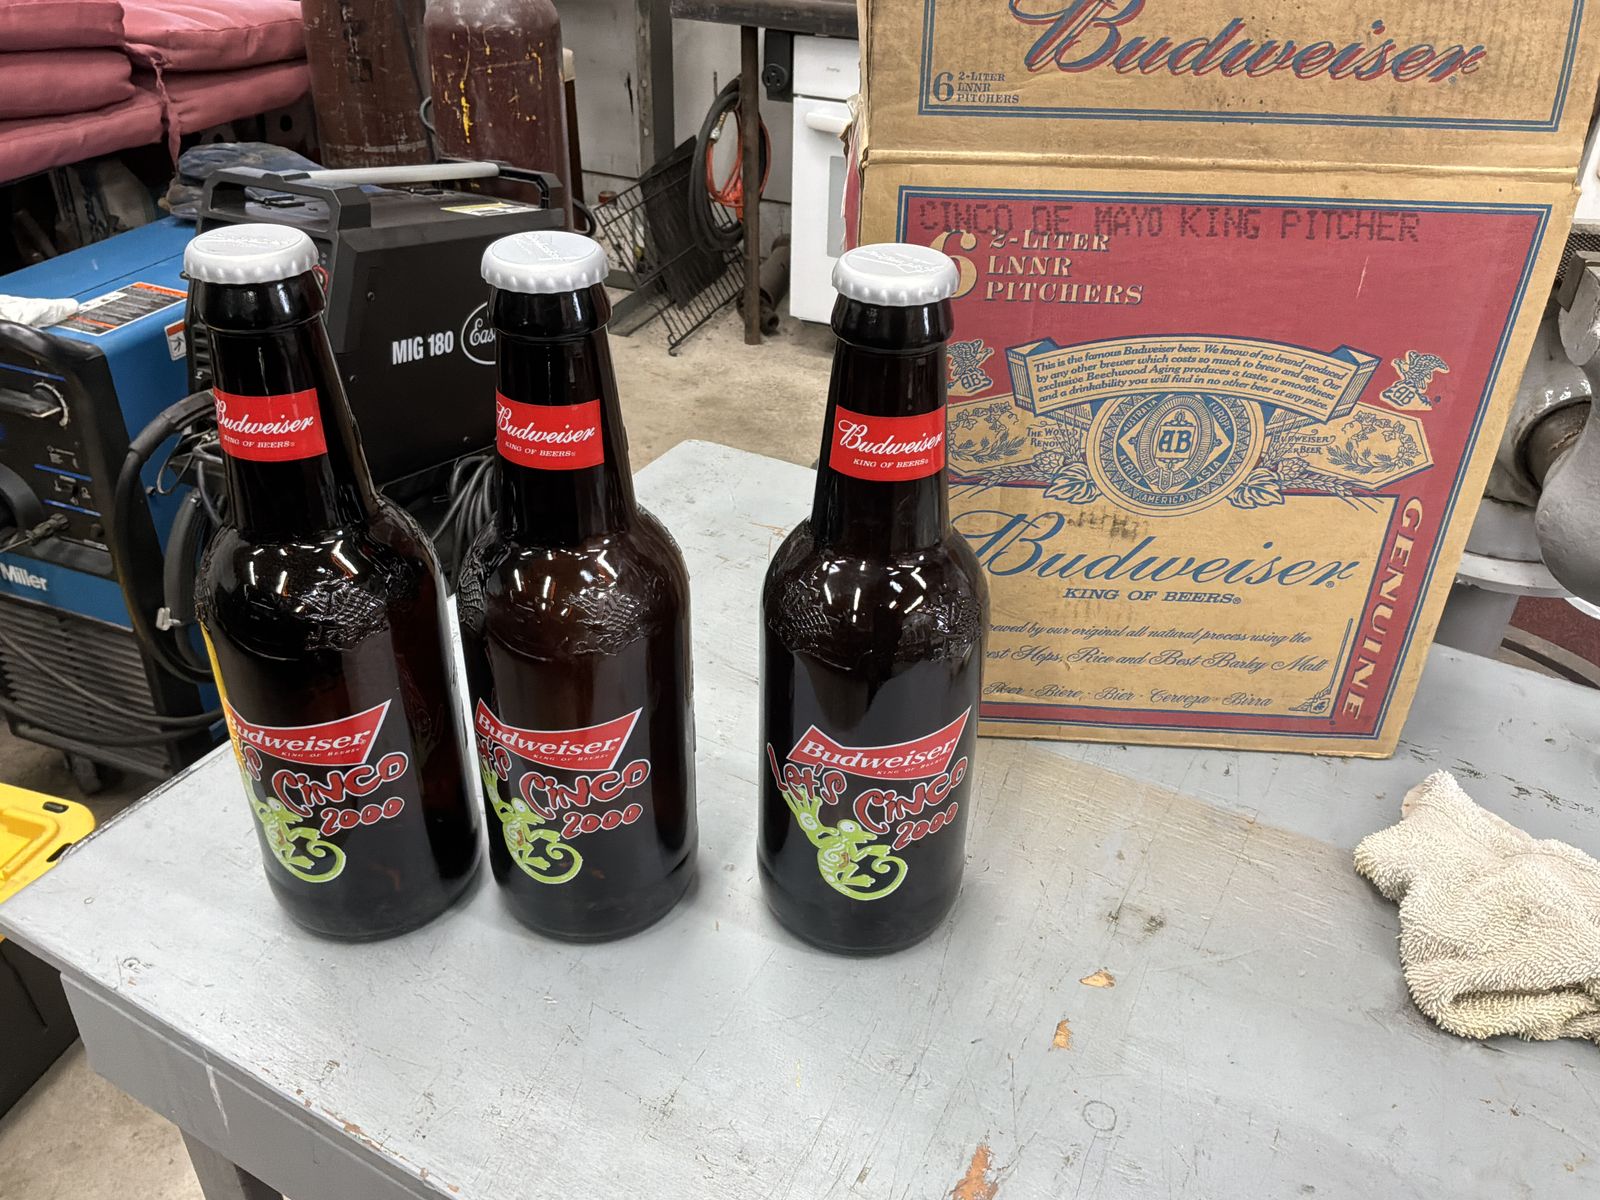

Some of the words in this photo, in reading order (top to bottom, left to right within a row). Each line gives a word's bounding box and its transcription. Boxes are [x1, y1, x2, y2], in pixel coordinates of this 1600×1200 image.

[1010, 0, 1487, 83] Budweiser
[933, 72, 954, 101] 6
[957, 82, 991, 92] LNNR
[958, 71, 1005, 82] 2-LITER
[957, 93, 1020, 104] PITCHERS
[920, 201, 1013, 235] CINCO
[1032, 205, 1073, 236] DE
[1094, 206, 1163, 237] MAYO
[1180, 207, 1262, 240] KING
[1280, 209, 1421, 243] PITCHER
[989, 228, 1110, 252] 2-LITER
[986, 255, 1073, 278] LNNR
[984, 280, 1143, 306] PITCHERS
[392, 336, 424, 365] MIG
[427, 330, 454, 357] 180
[470, 318, 497, 347] Eas
[1034, 361, 1056, 373] This
[1057, 358, 1066, 368] is
[1067, 355, 1083, 367] the
[1085, 350, 1122, 363] famous
[1123, 344, 1177, 356] Budweiser
[1203, 344, 1219, 354] We
[1220, 345, 1249, 357] know
[1250, 349, 1262, 359] of
[1262, 352, 1275, 361] no
[1275, 353, 1305, 367] brand
[1302, 362, 1349, 380] produced
[1036, 373, 1048, 383] by
[1050, 370, 1069, 380] any
[1071, 364, 1098, 375] other
[1100, 358, 1136, 369] brewer
[1137, 353, 1169, 365] which
[1171, 355, 1196, 364] costs
[1198, 356, 1210, 364] so
[1212, 355, 1241, 367] much
[1243, 359, 1254, 369] to
[1255, 360, 1281, 373] brew
[1281, 366, 1304, 379] and
[1322, 378, 1342, 391] Our
[1038, 377, 1084, 393] exclusive
[1086, 365, 1148, 382] Beechwood
[1148, 365, 1182, 375] Aging
[1181, 364, 1231, 377] produces
[1279, 379, 1336, 400] smoothness
[1039, 390, 1059, 402] and
[1060, 390, 1067, 398] a
[1069, 377, 1127, 395] drinkability
[1127, 377, 1149, 388] you
[1151, 374, 1170, 384] will
[1171, 373, 1192, 384] find
[1194, 374, 1205, 384] in
[1206, 377, 1221, 385] no
[1222, 378, 1250, 389] other
[1250, 382, 1271, 394] beer
[1273, 387, 1285, 396] at
[1285, 391, 1304, 402] any
[214, 396, 314, 435] Budweiser
[496, 400, 596, 444] Budweiser
[1122, 398, 1159, 432] AUSTRALIA
[1209, 401, 1232, 432] EUROPE
[242, 440, 255, 448] OF
[838, 419, 943, 455] Budweiser
[1026, 426, 1042, 437] THE
[1158, 429, 1193, 453] AB
[524, 447, 537, 455] OF
[853, 458, 877, 468] KING
[880, 461, 893, 469] OF
[1118, 453, 1145, 484] AFRICA
[1195, 460, 1222, 483] ASIA
[1142, 493, 1188, 505] AMERICA
[950, 510, 1360, 587] Budweiser
[0, 562, 48, 591] Miller
[1062, 587, 1121, 601] KING
[1127, 588, 1158, 601] OF
[1342, 496, 1423, 720] GENUINE
[1028, 622, 1046, 638] by
[1046, 627, 1072, 635] our
[1071, 625, 1126, 640] original
[1126, 625, 1151, 638] all
[1148, 627, 1203, 639] natural
[1194, 629, 1249, 644] process
[1249, 632, 1289, 647] using
[1289, 632, 1313, 644] the
[1066, 646, 1115, 663] Rice
[1115, 651, 1151, 665] and
[1149, 650, 1202, 666] Best
[1200, 651, 1268, 674] Barley
[1271, 655, 1329, 672] Malt
[227, 712, 371, 751] Budweiser
[478, 712, 622, 756] Budweiser
[800, 737, 956, 769] Budweiser
[320, 797, 405, 837] 2000
[561, 803, 643, 840] 2000
[892, 802, 959, 851] 2000
